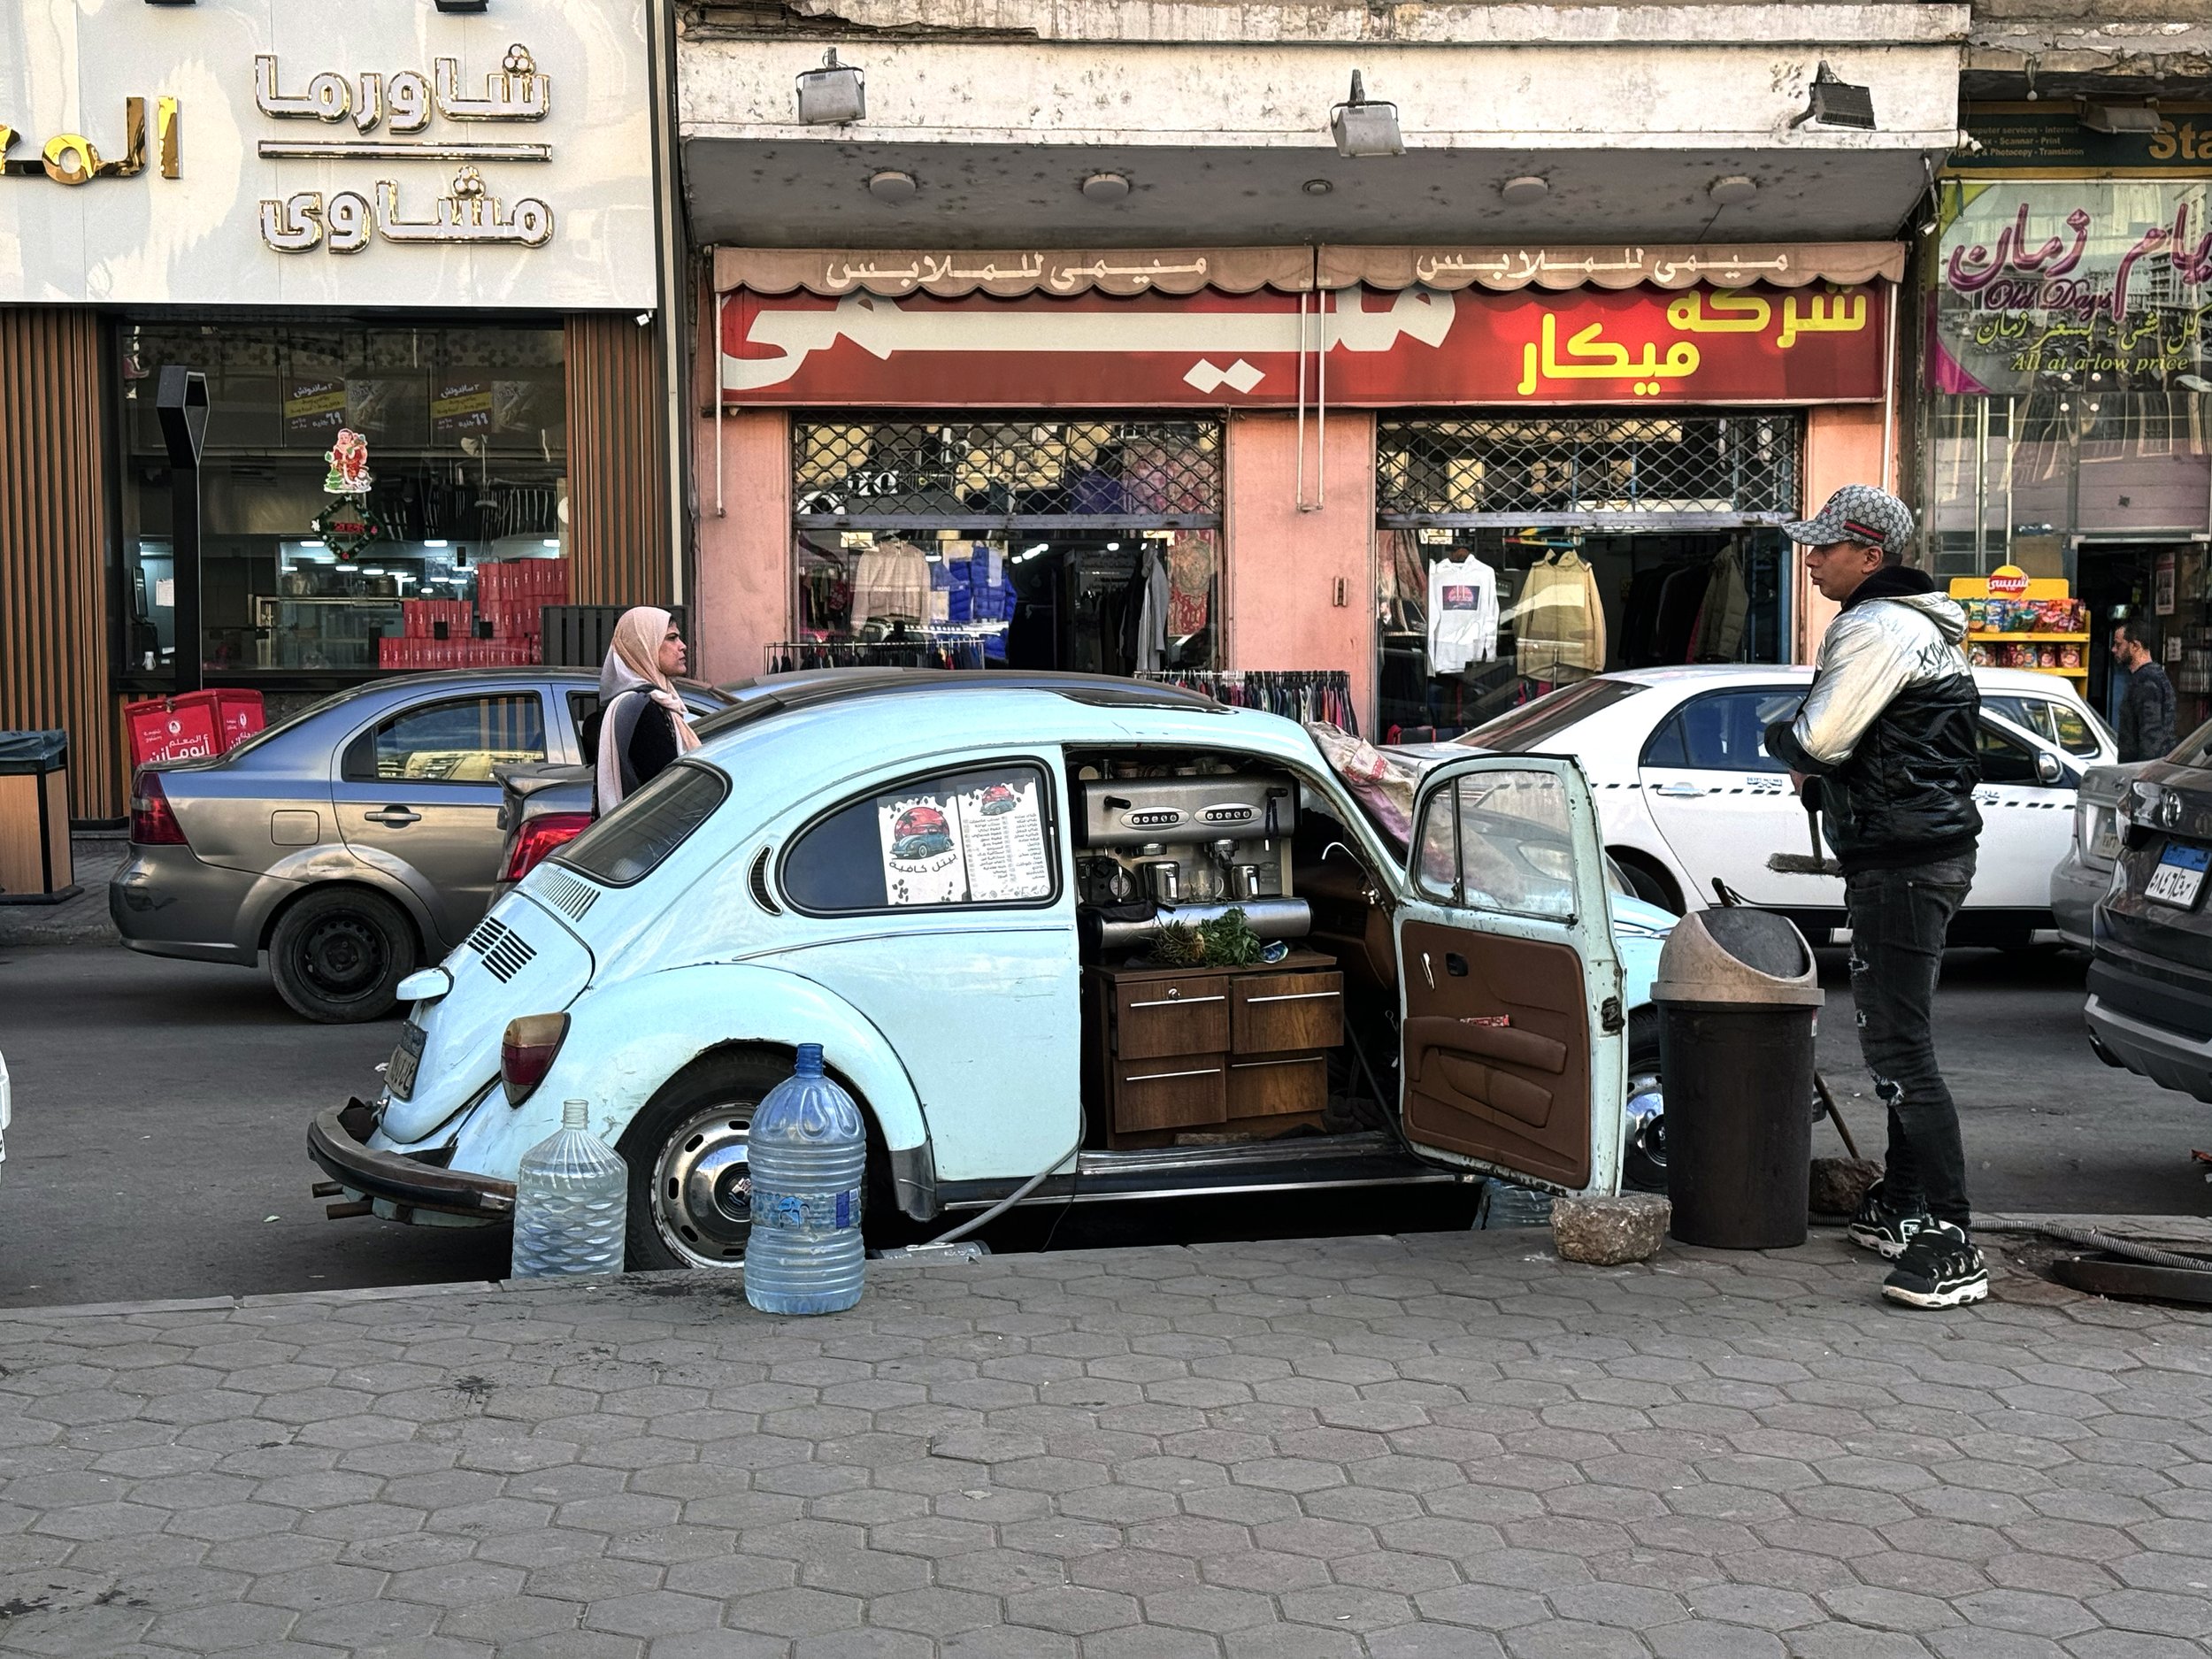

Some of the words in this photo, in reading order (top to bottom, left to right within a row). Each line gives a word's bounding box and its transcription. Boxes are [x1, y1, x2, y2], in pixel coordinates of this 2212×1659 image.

[254, 43, 551, 135] شاورما
[1990, 148, 2033, 157] Photocopy
[2039, 147, 2085, 156] Translation
[2040, 136, 2061, 145] Print
[1416, 248, 1645, 281] للملابس
[1947, 202, 2091, 293] زمان
[826, 251, 1044, 288] للملابس
[1984, 279, 2034, 310] Old
[2042, 279, 2115, 322] Days
[1976, 309, 2029, 345] زمان
[2029, 319, 2095, 350] بسعر
[1517, 313, 1701, 396] ميكار
[2010, 354, 2041, 372] All
[2047, 356, 2069, 371] at
[2093, 353, 2131, 371] low
[2135, 355, 2189, 374] price
